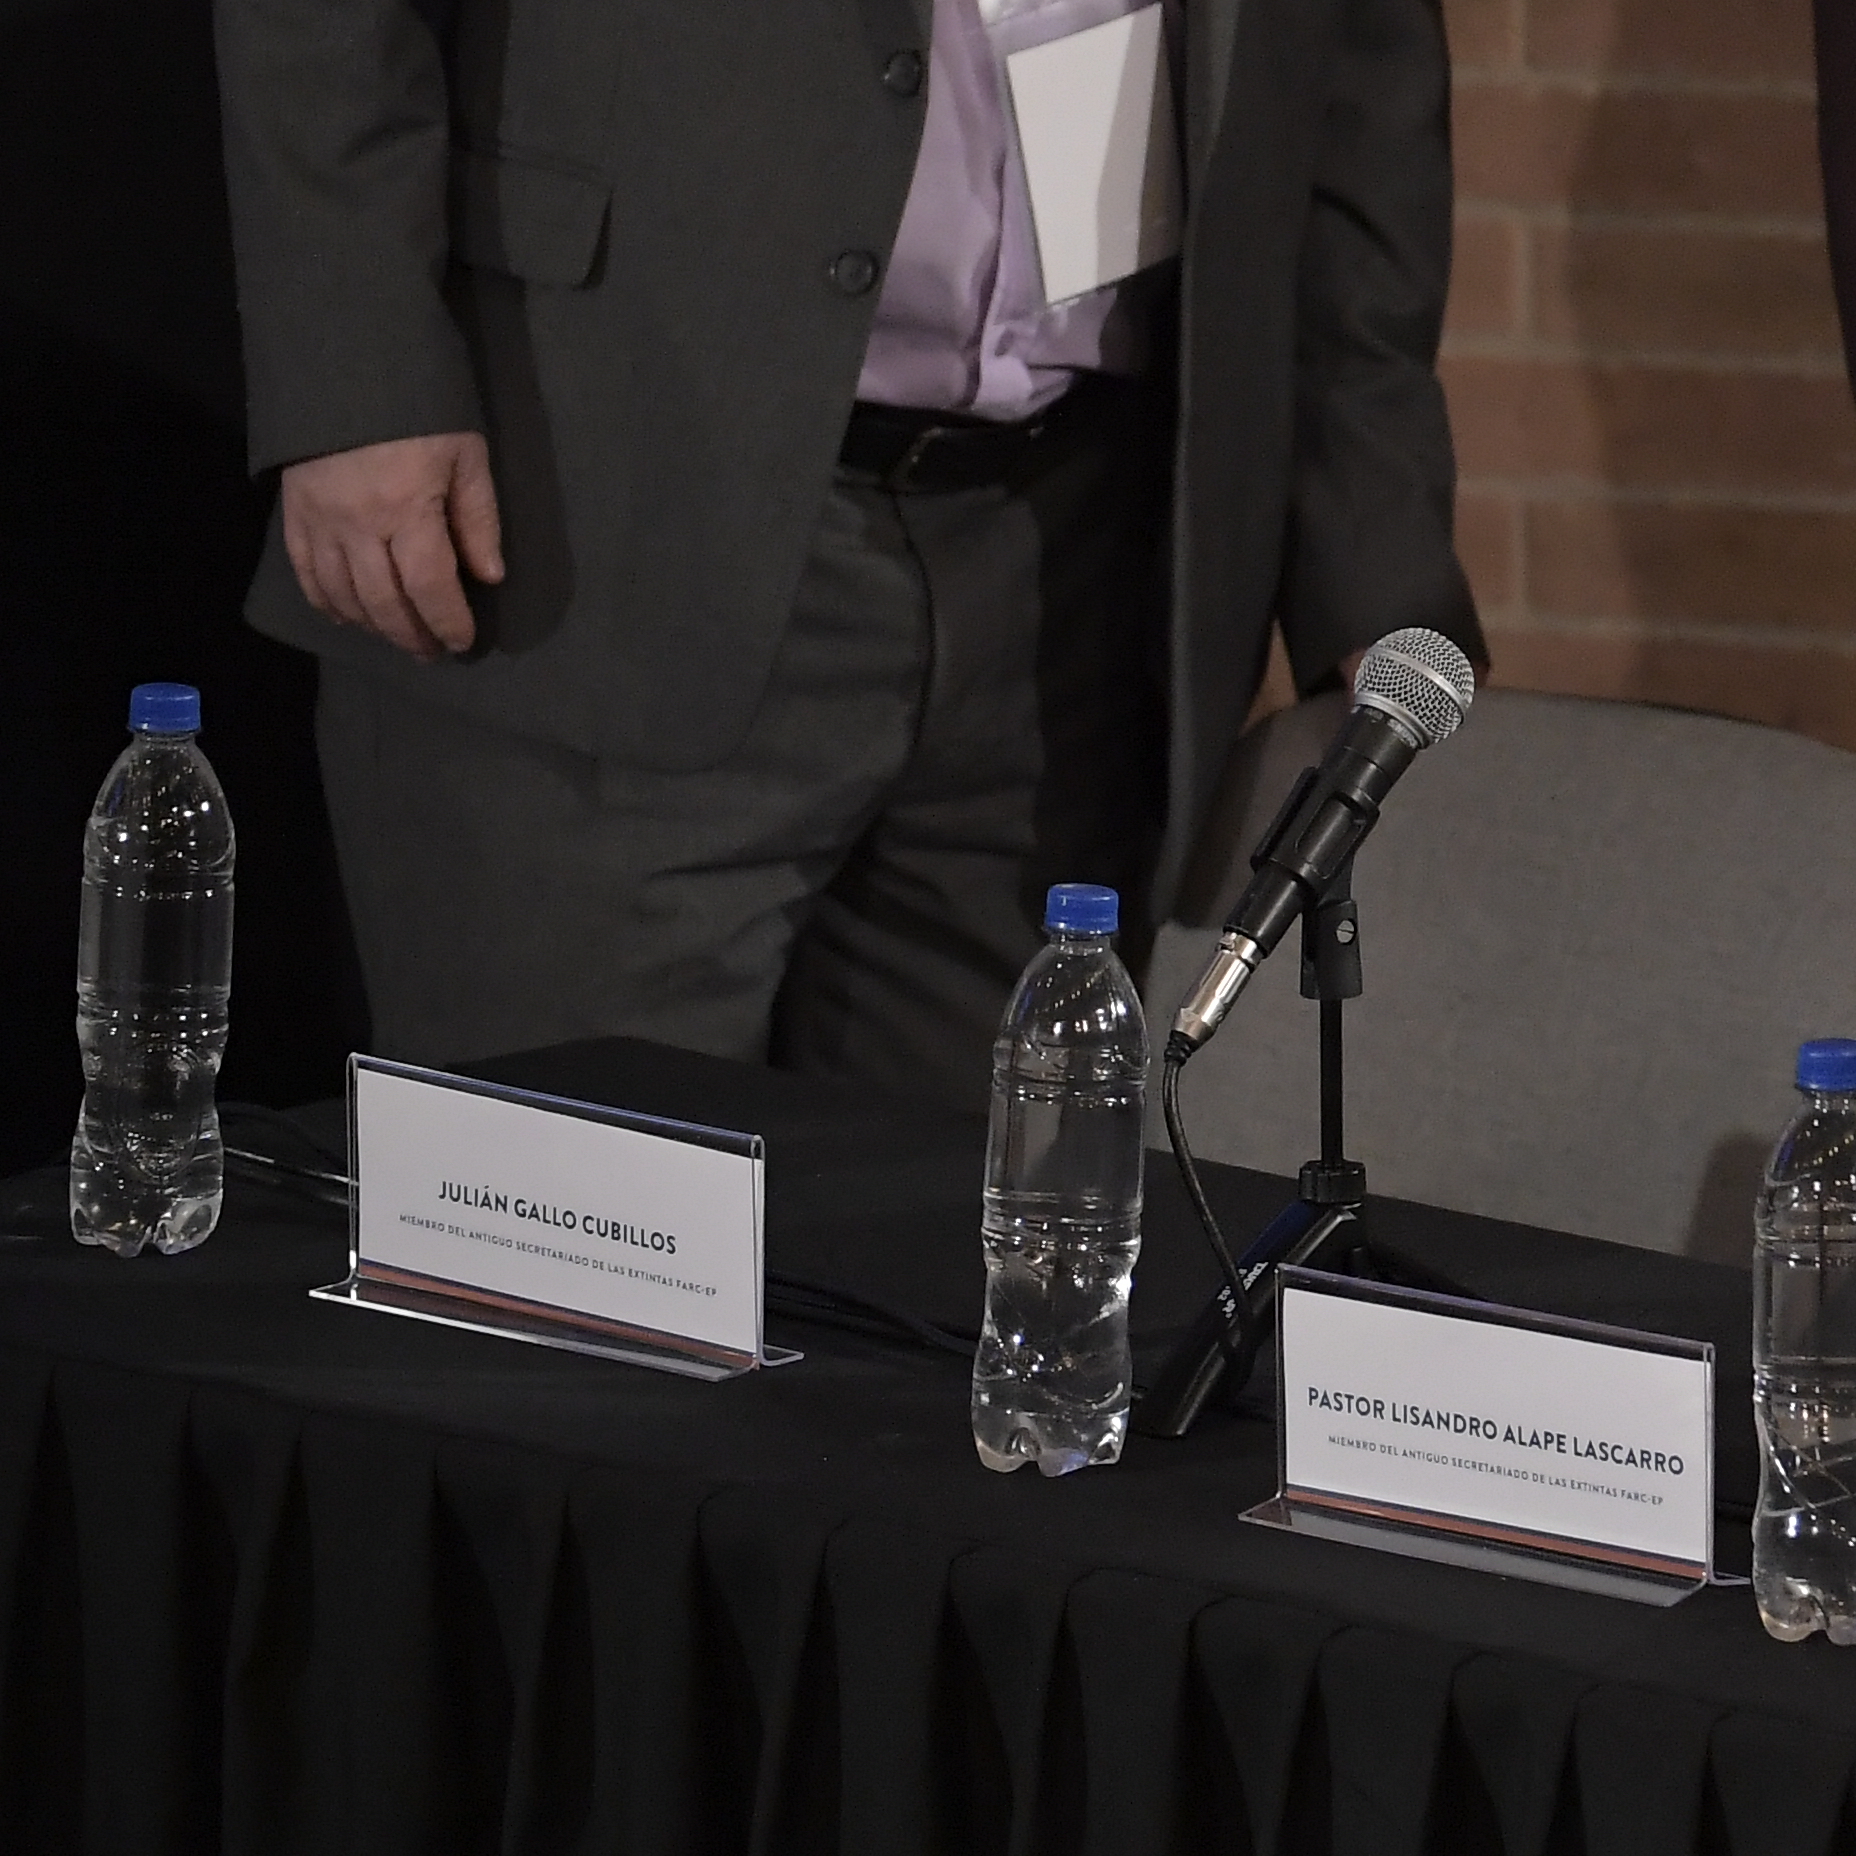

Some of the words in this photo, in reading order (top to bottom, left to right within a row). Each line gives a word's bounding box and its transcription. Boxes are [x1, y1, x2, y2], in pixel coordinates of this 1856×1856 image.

[399, 1214, 445, 1232] MIEMBRO
[448, 1225, 465, 1238] DEL
[469, 1231, 513, 1248] ANTIGUO
[516, 1241, 589, 1267] SECRETARIADO
[592, 1259, 604, 1271] DE
[608, 1263, 625, 1275] LAS
[628, 1268, 673, 1287] EXTINTAS
[676, 1280, 717, 1296] FARC-EP
[438, 1181, 508, 1214] JULIÁN
[514, 1198, 577, 1230] GALLO
[582, 1215, 676, 1255] CUBILLOS
[1308, 1387, 1385, 1420] PASTOR
[1392, 1402, 1498, 1440] LISANDRO
[1503, 1424, 1567, 1454] ALAPE
[1573, 1436, 1684, 1475] LASCARRO
[1328, 1435, 1377, 1452] MIEMBRO
[1380, 1444, 1398, 1456] DEL
[1402, 1448, 1448, 1465] ANTIGUO
[1451, 1457, 1528, 1481] SECRETARIADO
[1532, 1473, 1545, 1484] DE
[1549, 1476, 1567, 1488] LAS
[1570, 1479, 1617, 1498] EXTINTAS
[1621, 1489, 1664, 1506] FARC-EP
